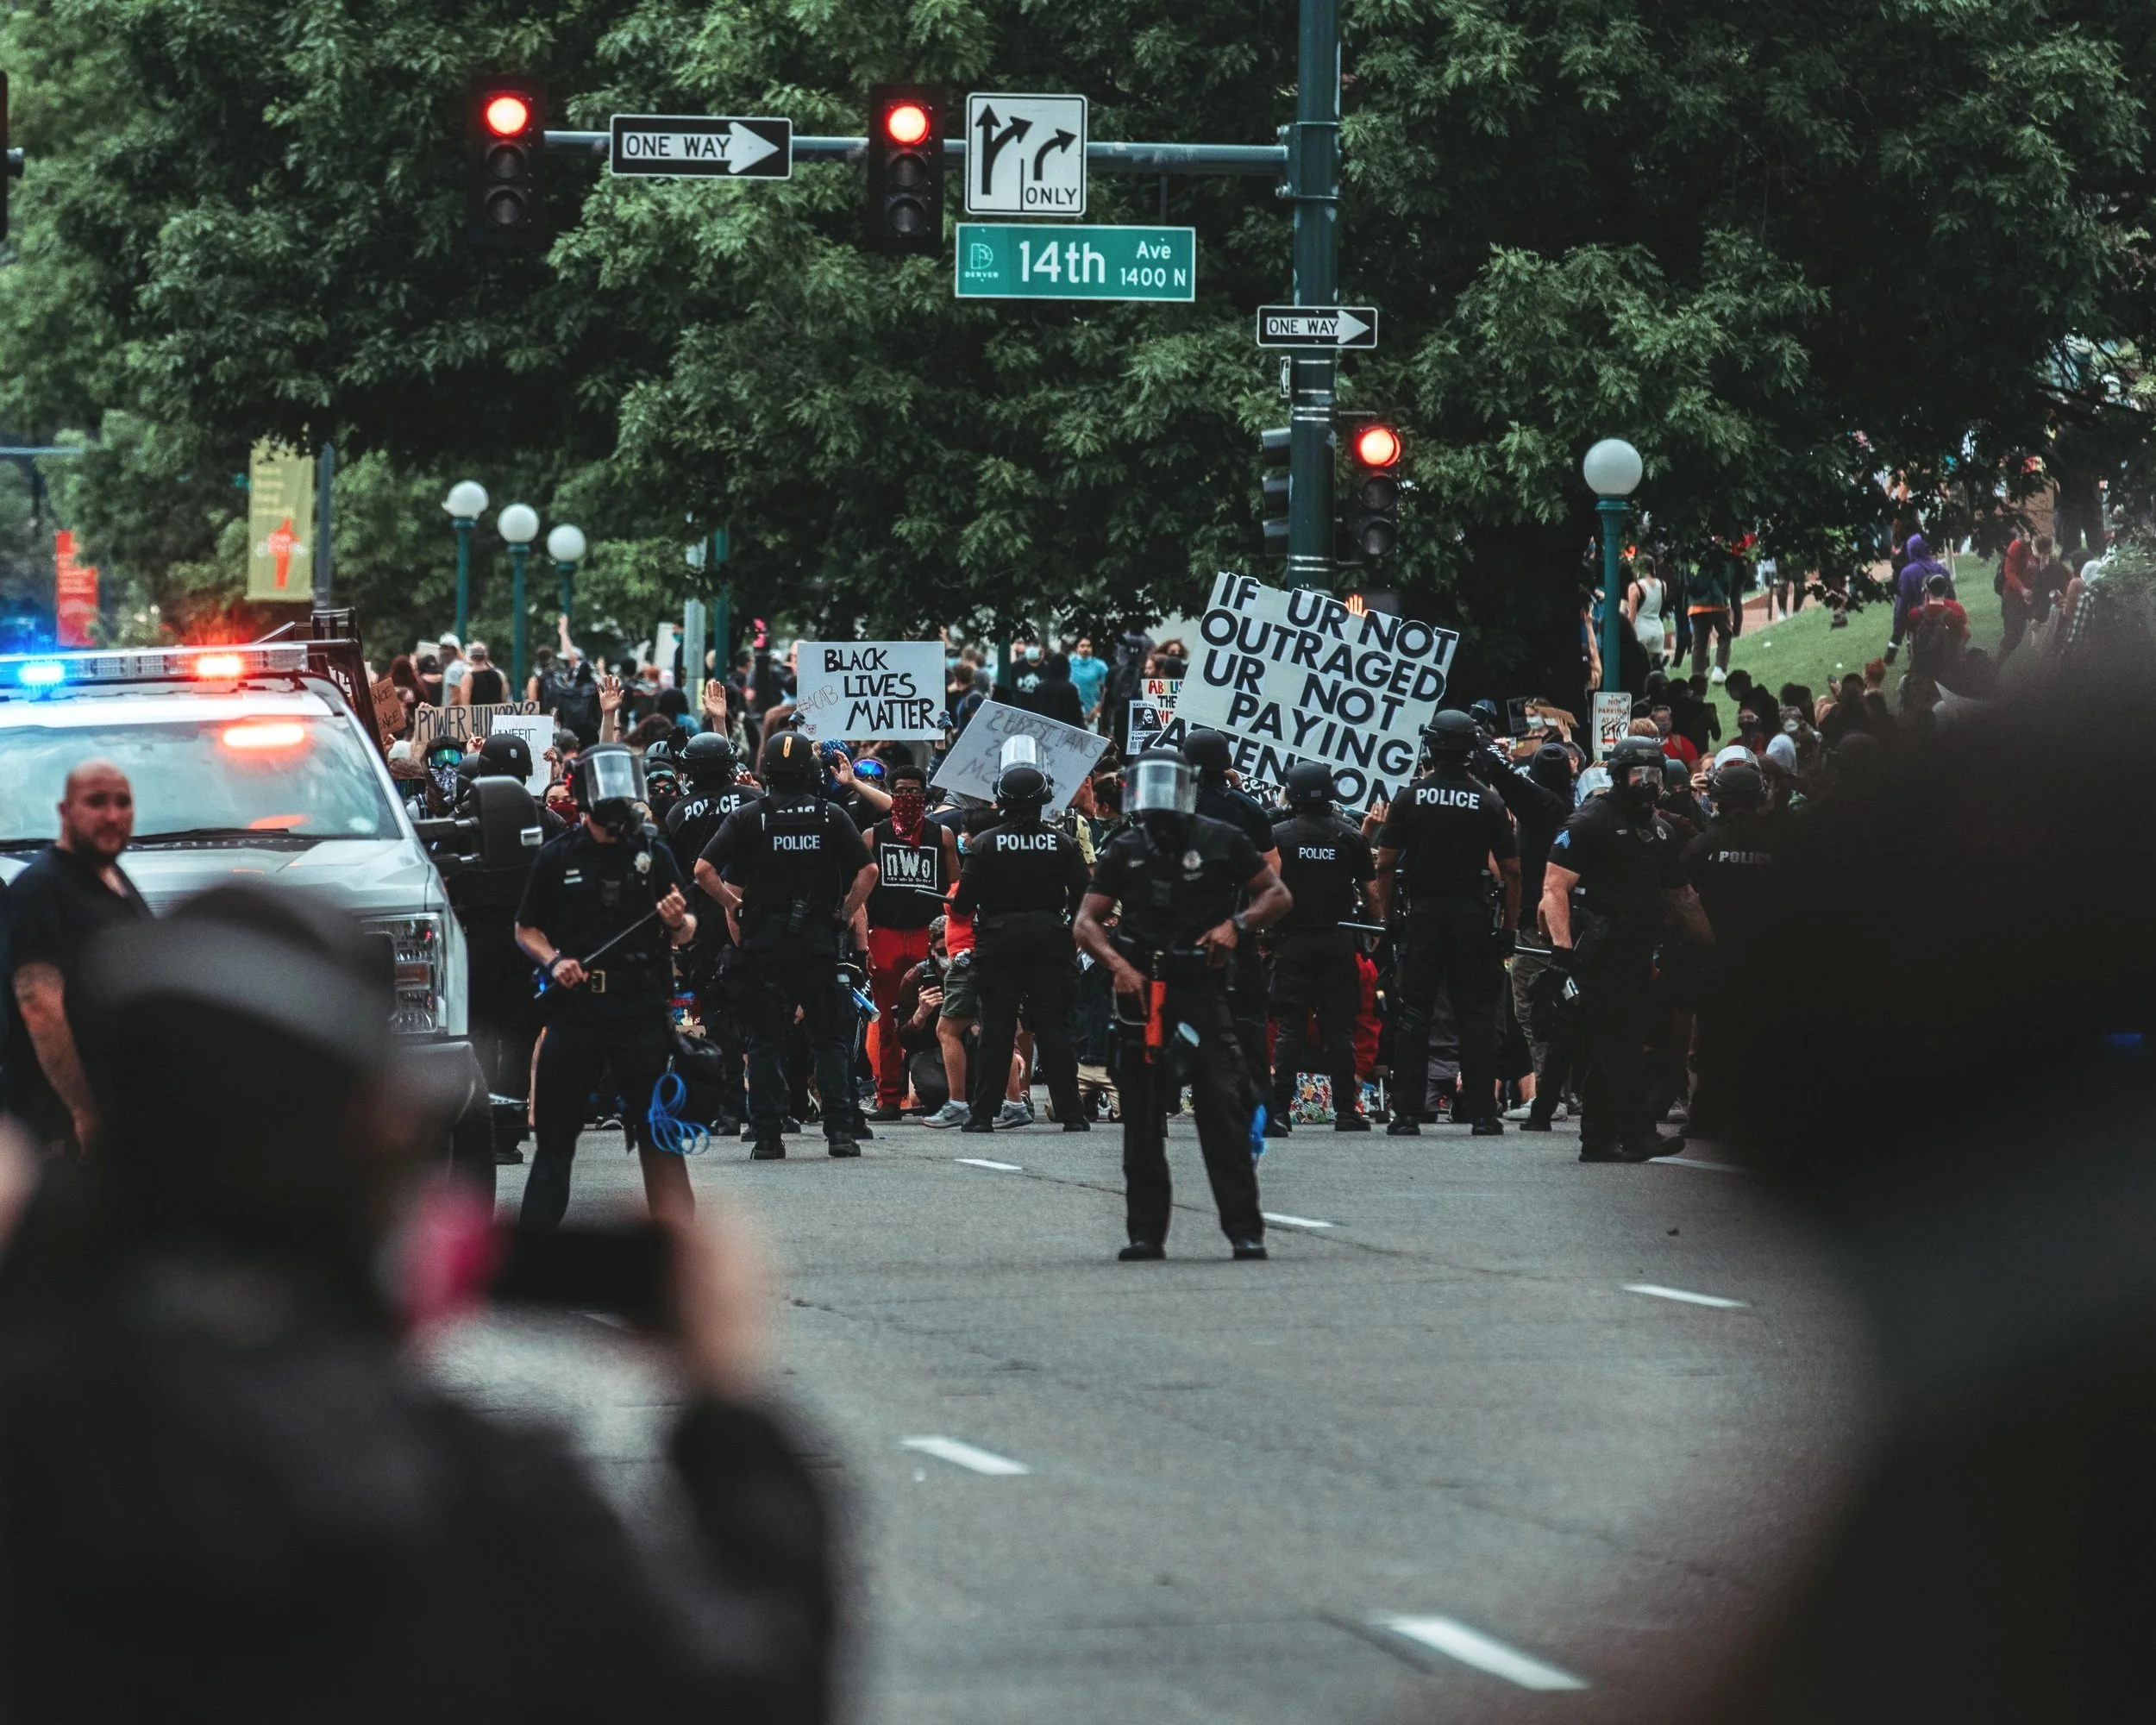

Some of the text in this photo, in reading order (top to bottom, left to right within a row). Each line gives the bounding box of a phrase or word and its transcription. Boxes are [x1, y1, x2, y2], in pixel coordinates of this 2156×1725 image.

[626, 135, 730, 158] ONE WAY
[1025, 186, 1078, 205] ONLY
[1018, 241, 1106, 284] 14th
[1136, 241, 1171, 260] Ave
[1121, 267, 1187, 287] 1400 N
[1269, 319, 1338, 335] ONE WAY
[1219, 573, 1457, 666] IF UR NOT
[824, 648, 889, 673] BLACK
[1200, 609, 1447, 703] OUTRAGED
[844, 673, 917, 699] LIVES
[1203, 649, 1406, 732] UR NOT
[797, 685, 839, 714] #ACAB
[1157, 695, 1178, 709] THE
[418, 707, 468, 742] POWER
[845, 698, 937, 731] MATTER
[1226, 692, 1414, 776] PAYING
[1415, 787, 1481, 810] POLICE
[774, 835, 820, 850] POLICE
[996, 834, 1057, 852] POLICE
[1299, 847, 1336, 860] POLICE
